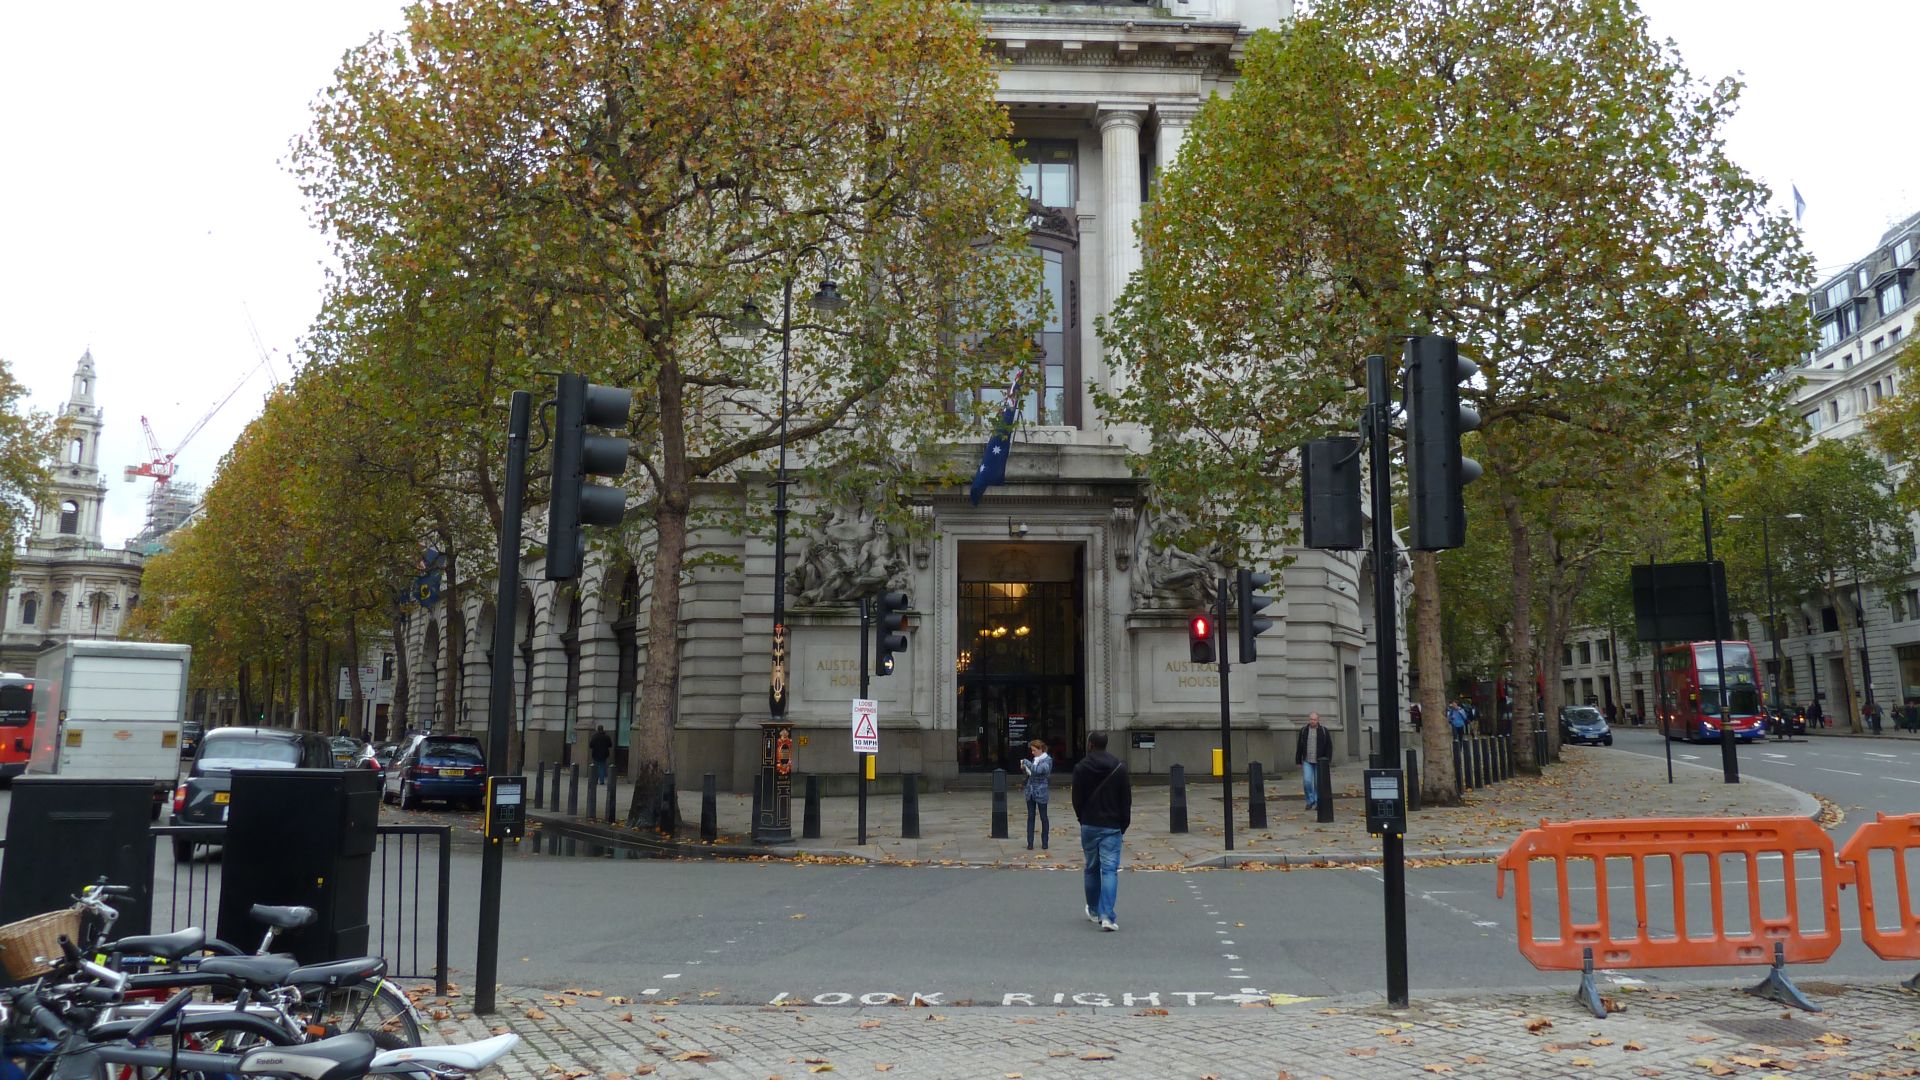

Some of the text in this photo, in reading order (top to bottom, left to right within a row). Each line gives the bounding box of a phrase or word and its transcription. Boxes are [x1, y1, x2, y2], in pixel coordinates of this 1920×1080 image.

[1179, 676, 1219, 687] HOUSE
[769, 992, 1214, 1007] LOOK RIGHT
